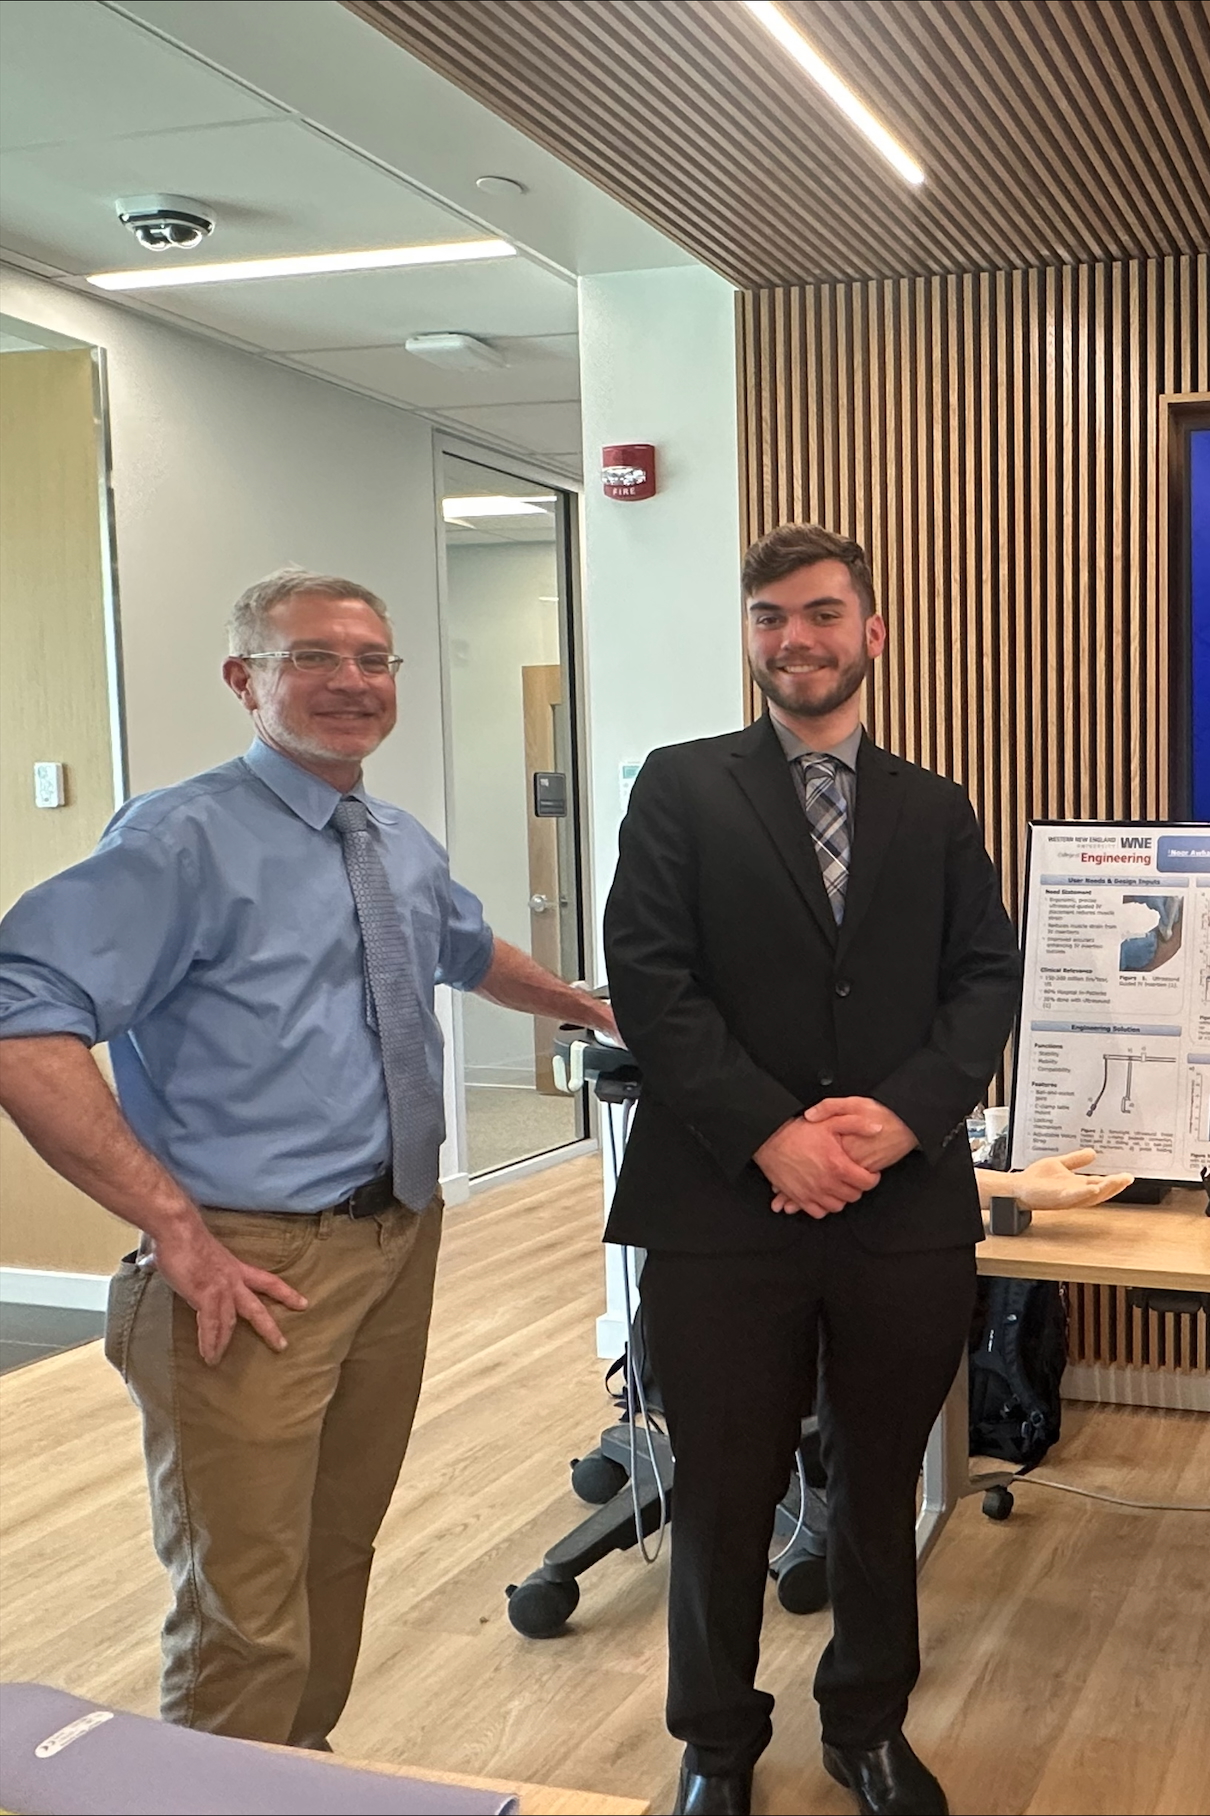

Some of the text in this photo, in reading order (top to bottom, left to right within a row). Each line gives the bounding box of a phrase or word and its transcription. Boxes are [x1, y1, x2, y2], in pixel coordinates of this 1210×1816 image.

[612, 487, 636, 496] FIRE
[1120, 837, 1152, 849] WNE
[1081, 852, 1152, 866] Engineering
[1139, 878, 1160, 886] Inputs
[1071, 1024, 1141, 1033] Engineering Solution
